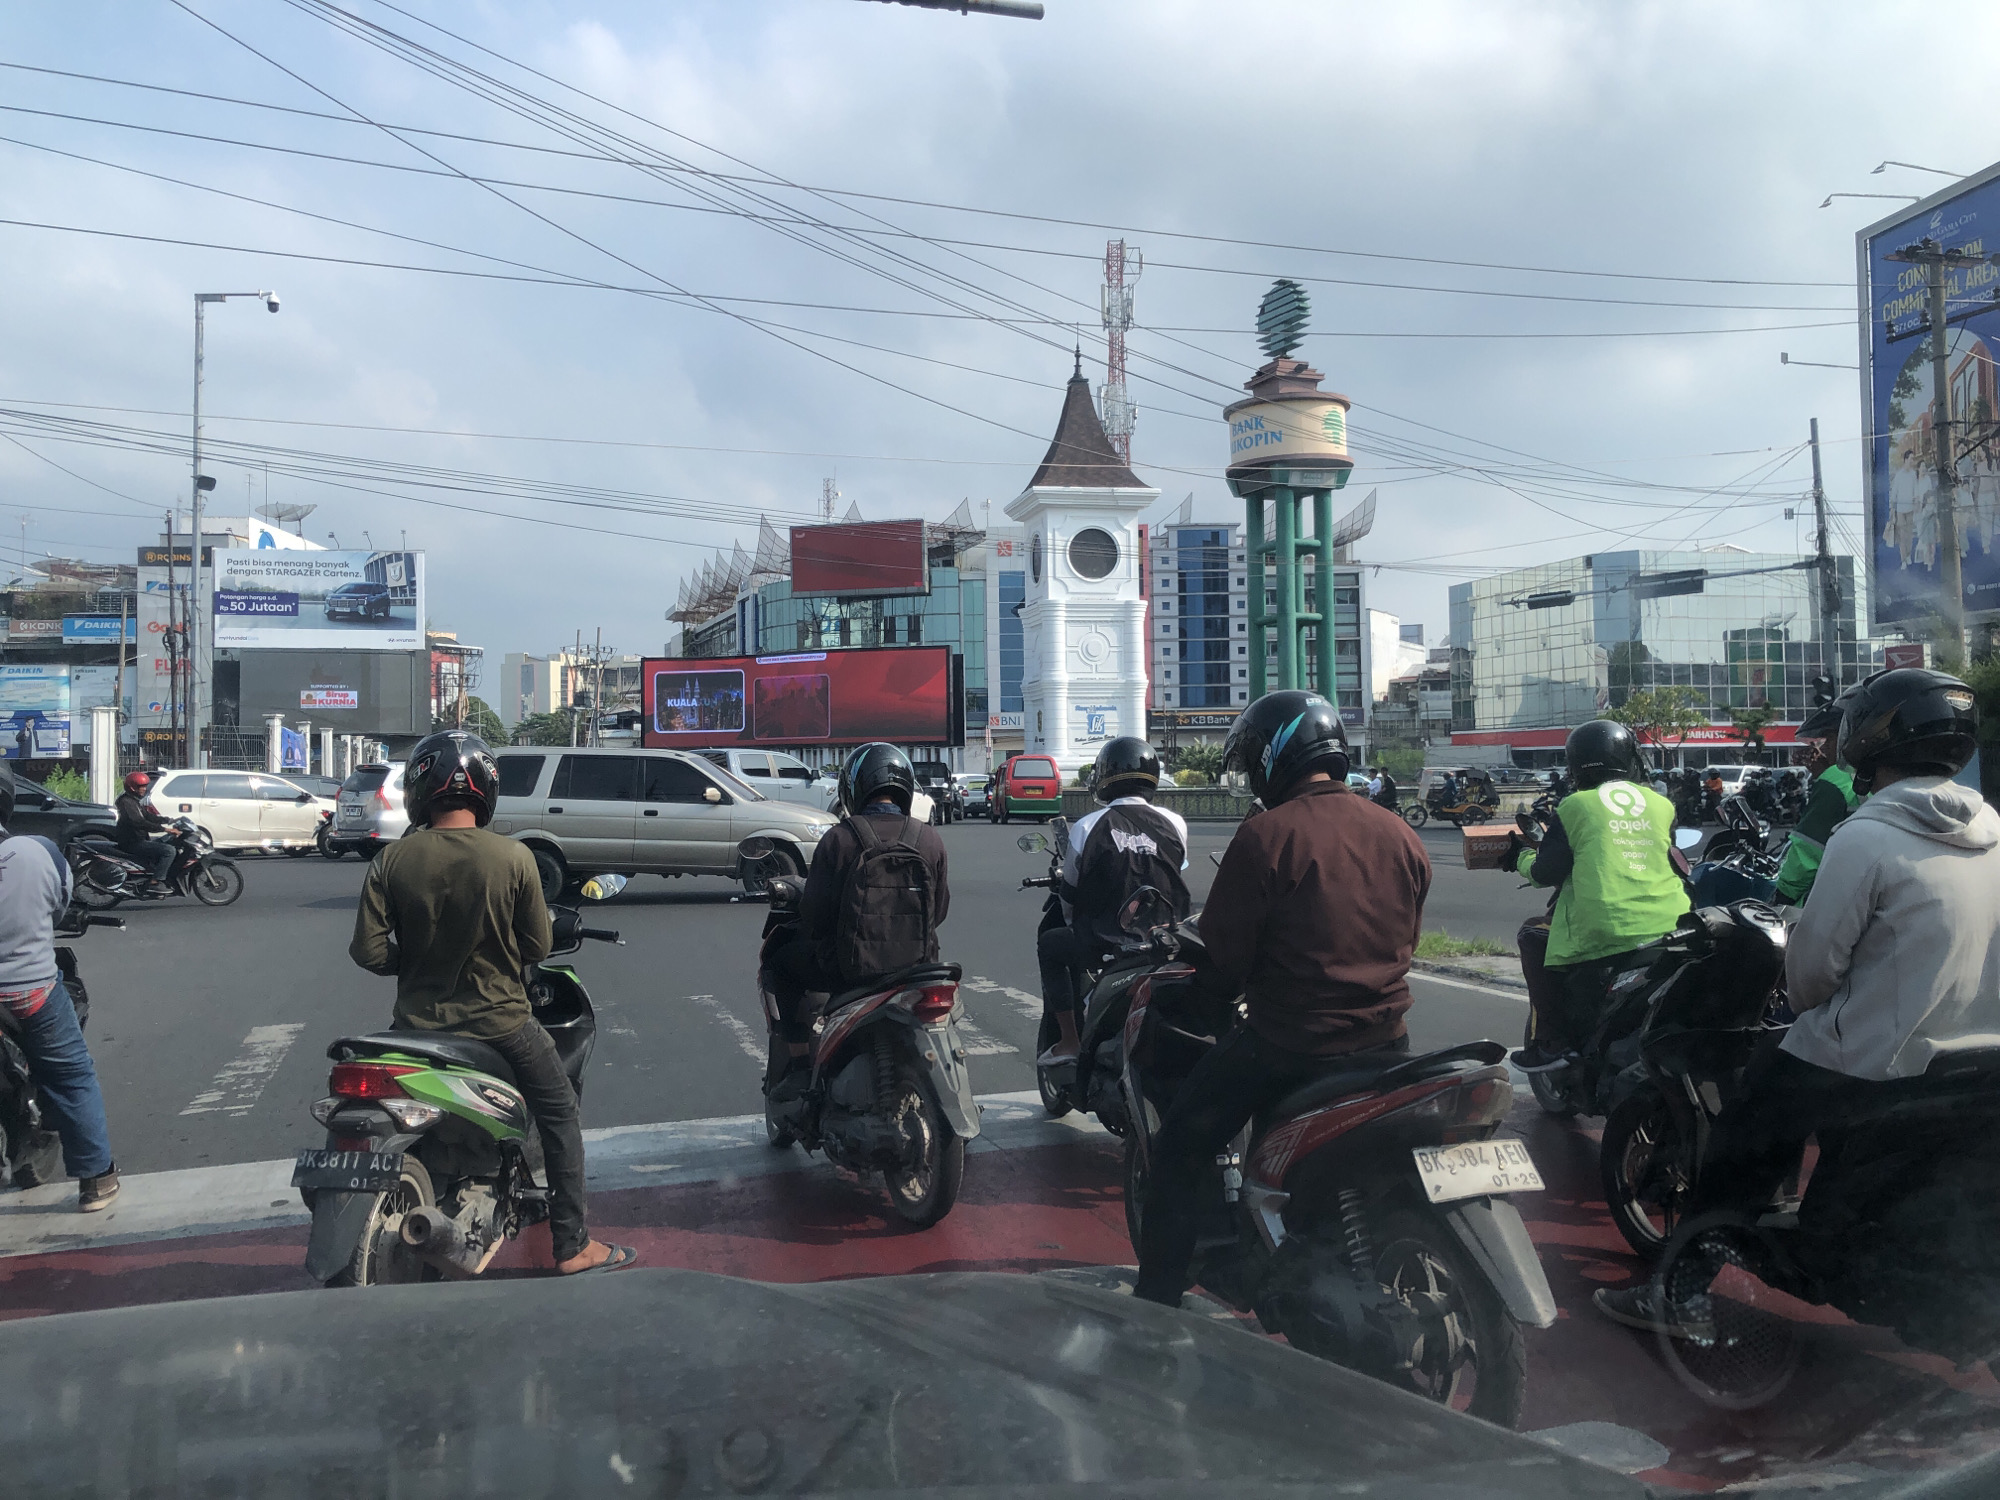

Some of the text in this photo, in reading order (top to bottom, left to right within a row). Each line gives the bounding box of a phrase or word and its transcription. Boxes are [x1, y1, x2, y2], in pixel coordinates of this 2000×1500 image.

[1965, 262, 1999, 291] AREA
[1232, 415, 1265, 437] BANK
[226, 558, 350, 570] Pasti bisa menang banyak
[226, 567, 362, 578] dengan STARGAZER Cartenz.
[219, 593, 248, 601] Potongan
[230, 602, 246, 612] 50
[325, 690, 349, 699] Sirup
[667, 698, 698, 707] KUALA
[1001, 716, 1021, 727] BNI
[1207, 715, 1231, 724] Bank
[1609, 818, 1652, 834] gojek
[1612, 838, 1654, 849] tokopedia
[1622, 851, 1648, 861] gopay
[1494, 1143, 1529, 1167] AEU
